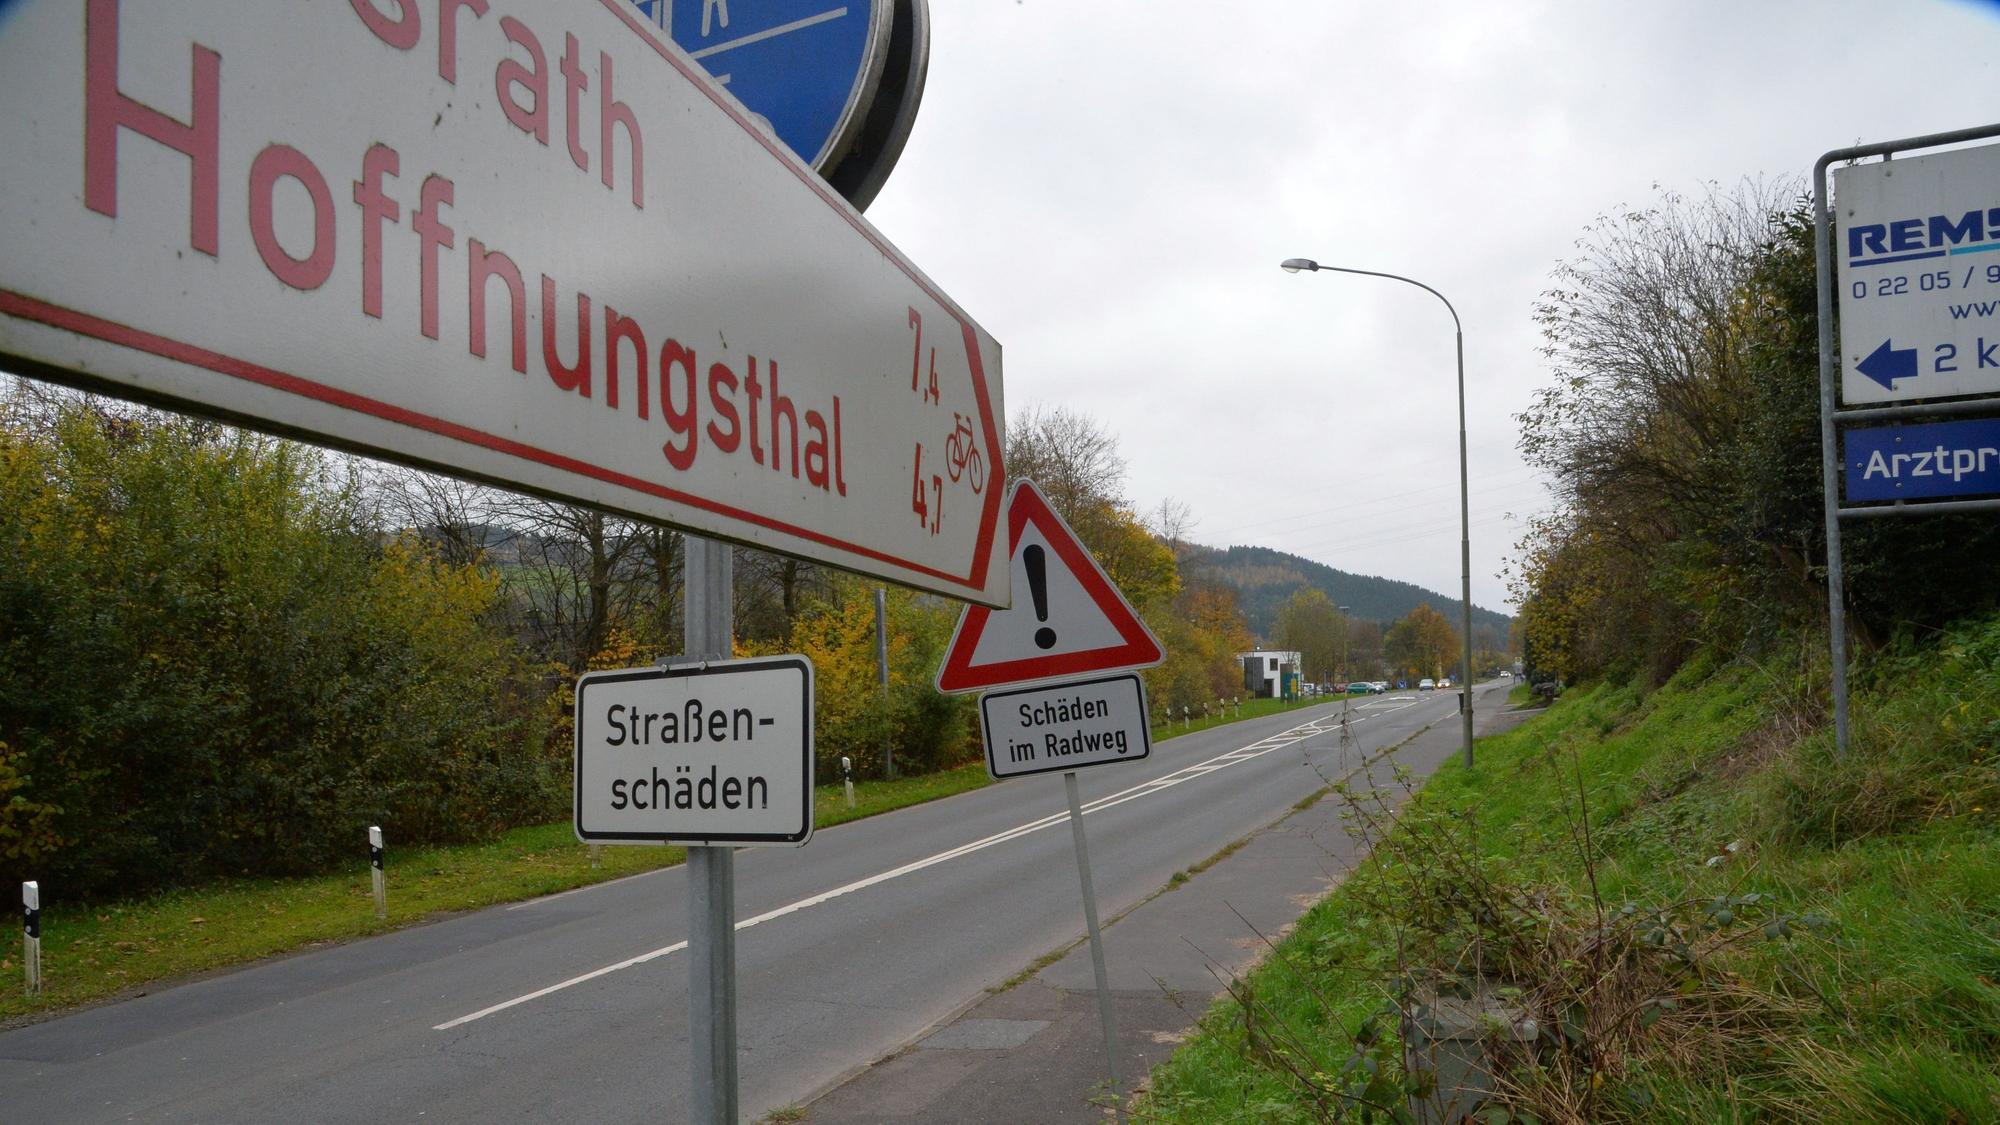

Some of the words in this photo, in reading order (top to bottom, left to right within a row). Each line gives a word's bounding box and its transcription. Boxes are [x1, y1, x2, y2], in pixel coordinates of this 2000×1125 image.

[86, 0, 847, 497] Hoffnungsthal
[913, 443, 942, 537] 4,7
[1878, 276, 1908, 297] 22
[1920, 271, 1950, 291] 05
[1949, 300, 2000, 319] ww
[908, 306, 939, 406] 7,4
[1934, 343, 1957, 372] 2
[1863, 445, 2000, 482] Arztpr
[606, 699, 774, 746] Straßen-
[1019, 696, 1109, 728] Schäden
[1008, 739, 1035, 763] im
[1045, 730, 1128, 758] Radweg
[610, 765, 768, 810] schäden
